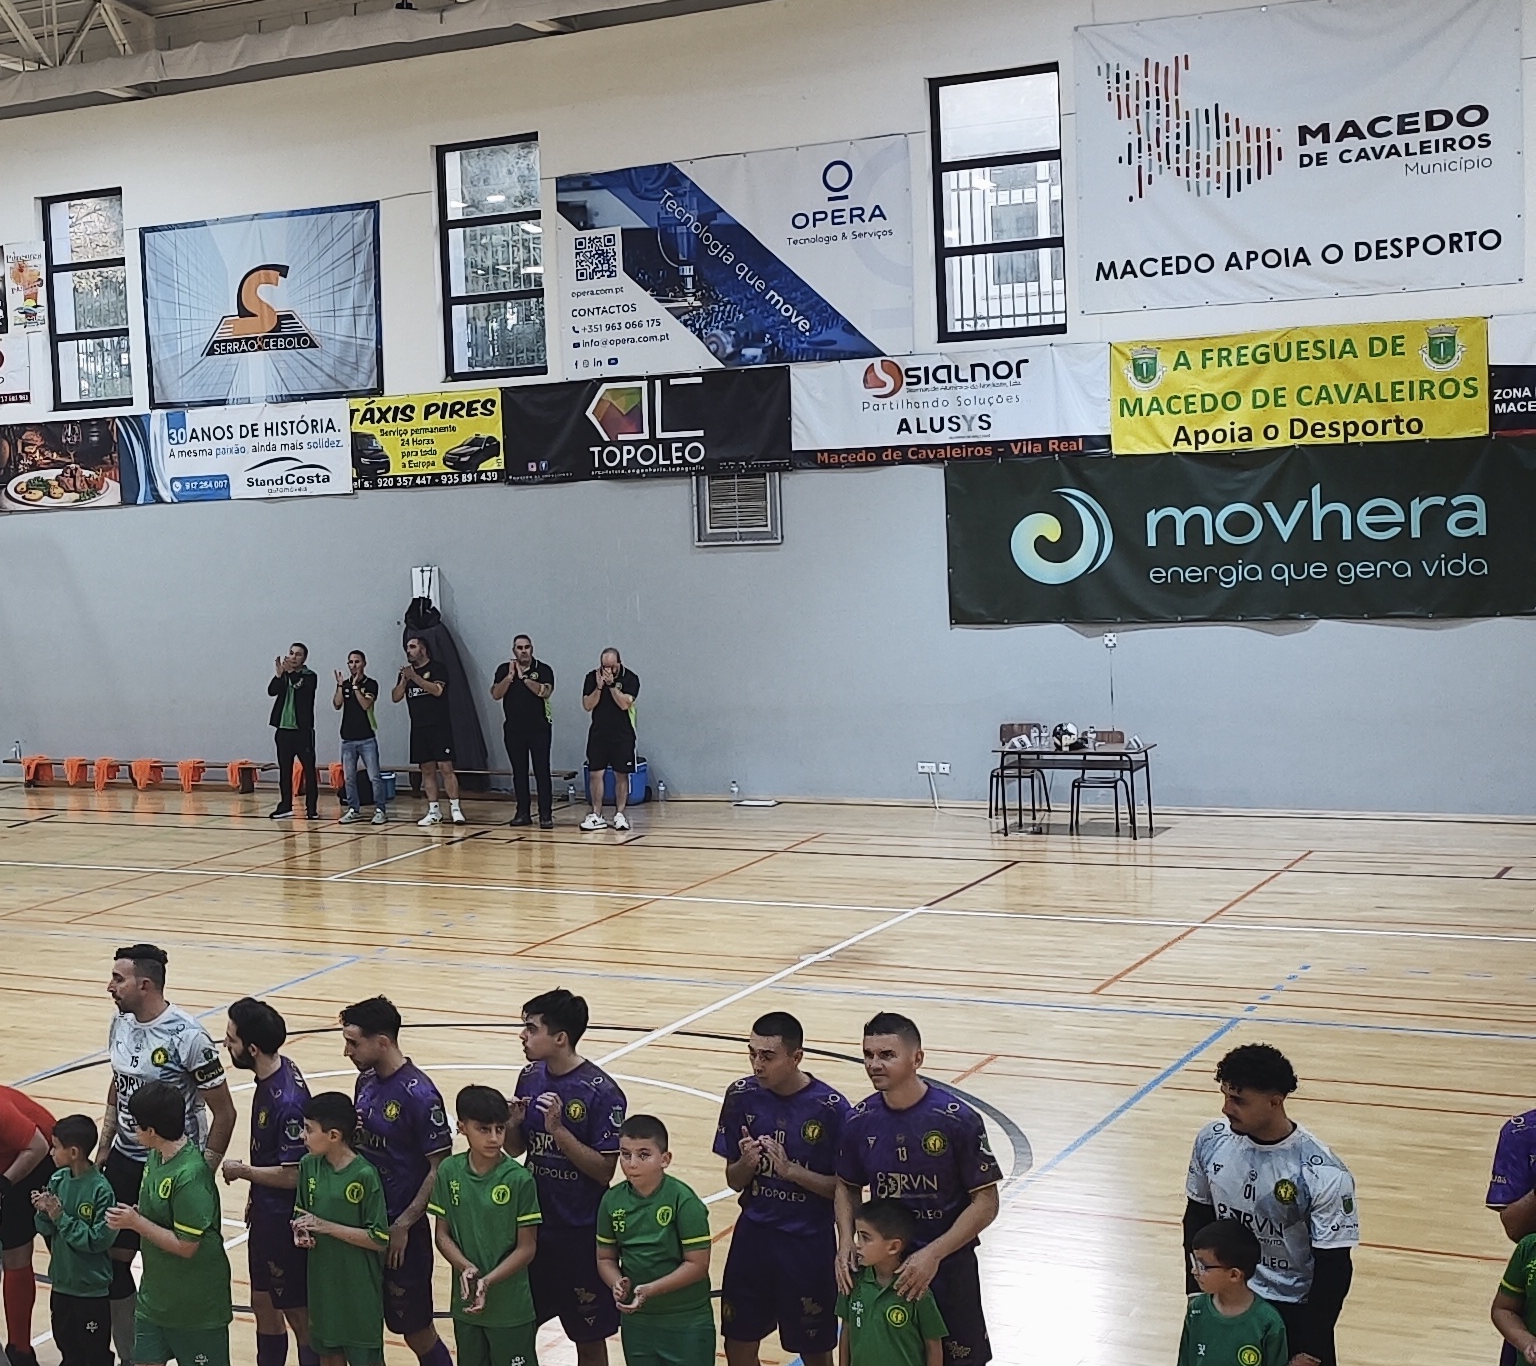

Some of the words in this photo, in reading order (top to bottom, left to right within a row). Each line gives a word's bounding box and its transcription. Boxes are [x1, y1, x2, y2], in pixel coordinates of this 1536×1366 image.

[1298, 104, 1489, 146] MACEDO
[1299, 152, 1328, 168] DE
[1339, 133, 1492, 163] CAVALEIROS
[1405, 157, 1493, 176] Município
[792, 205, 887, 229] OPERA
[659, 189, 735, 265] Tecnologia
[735, 263, 766, 292] que
[765, 290, 811, 336] move.
[1096, 253, 1215, 281] MACEDO
[1224, 247, 1312, 272] APOIA
[1321, 243, 1344, 265] O
[1354, 229, 1502, 262] DESPORTO
[572, 303, 637, 317] CONTACTOS
[646, 318, 661, 328] 175
[1172, 350, 1192, 372] A
[1201, 338, 1358, 369] FREGUESIA
[1368, 334, 1406, 358] DE
[862, 397, 949, 412] Partilhando
[1119, 390, 1242, 418] MACEDO
[1251, 385, 1288, 410] DE
[1295, 376, 1479, 408] CAVALEIROS
[1493, 387, 1532, 401] ZONA
[350, 400, 416, 425] TÁXIS
[424, 398, 497, 421] PIRES
[897, 413, 992, 435] ALUSYS
[168, 428, 186, 444] 30
[189, 424, 234, 443] ANOS
[240, 423, 259, 439] DE
[264, 414, 342, 437] HISTÓRIA.
[380, 427, 408, 437] Serviço
[1173, 420, 1253, 450] Apoia
[1263, 421, 1279, 441] o
[1289, 414, 1424, 445] Desporto
[169, 449, 176, 459] A
[178, 447, 213, 458] mesma
[252, 442, 277, 453] ainda
[280, 440, 304, 451] mais
[589, 441, 705, 468] TOPOLEO
[817, 448, 877, 464] Macedo
[882, 447, 903, 461] de
[908, 443, 993, 460] Cavaleiros
[1009, 441, 1042, 455] Vila
[1048, 437, 1084, 452] Real
[377, 478, 394, 487] 920
[396, 476, 413, 486] 357
[415, 475, 432, 485] 447
[1147, 482, 1487, 547] movhera
[1150, 559, 1262, 588] energia
[1271, 559, 1327, 586] que
[1336, 558, 1411, 585] gera
[1421, 553, 1489, 577] vida
